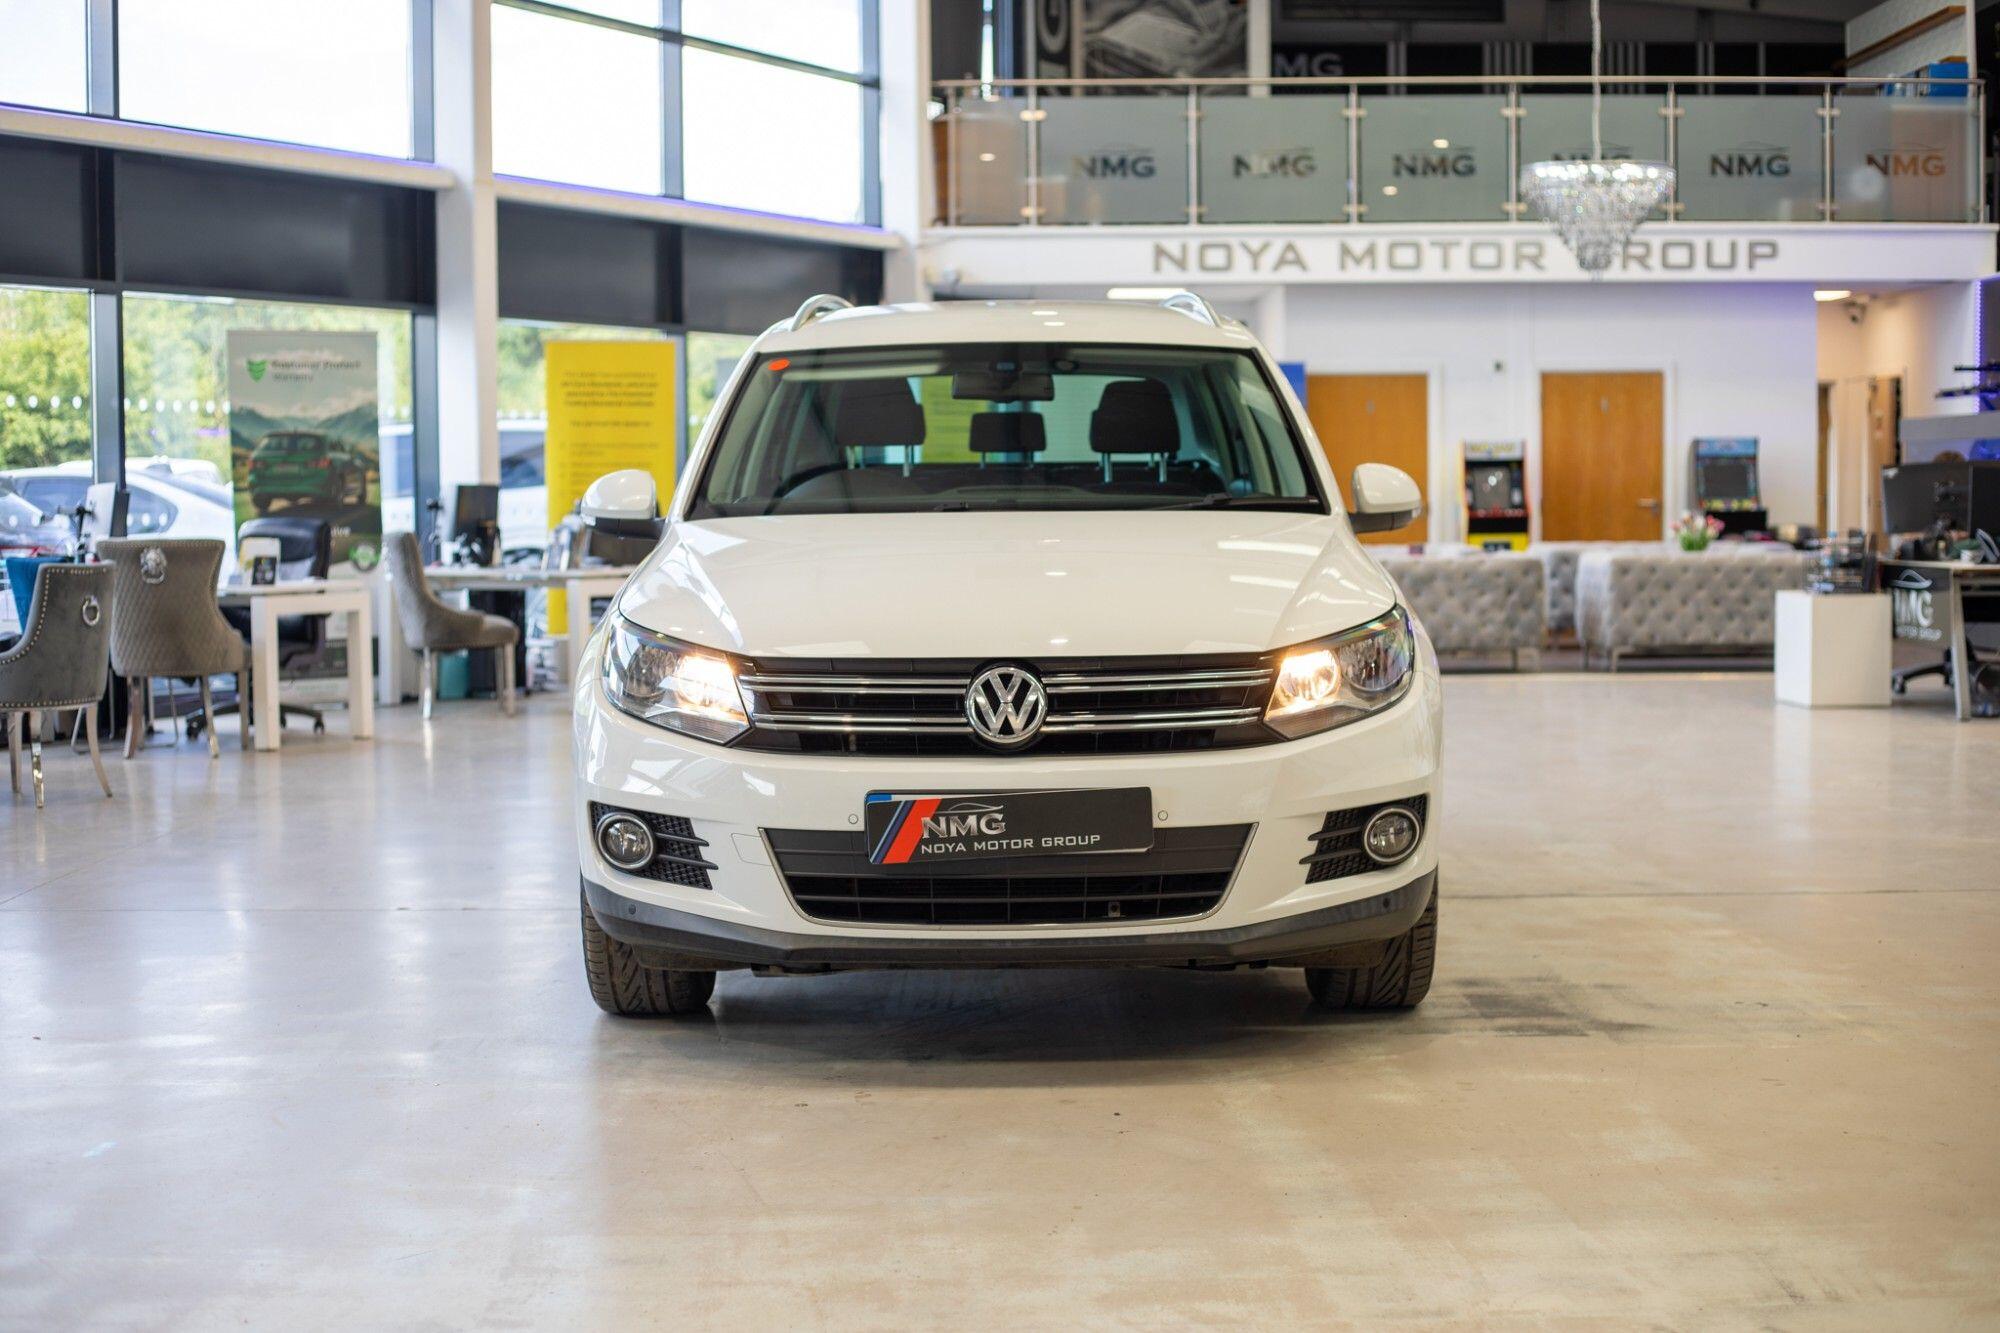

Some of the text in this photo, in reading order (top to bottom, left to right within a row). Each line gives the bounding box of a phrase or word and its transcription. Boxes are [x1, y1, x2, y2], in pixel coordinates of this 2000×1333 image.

[1072, 156, 1155, 178] NMG
[1394, 154, 1476, 178] NMG
[1711, 153, 1791, 178] NMG
[1866, 153, 1947, 177] NMG
[1153, 241, 1779, 271] NOYA MOTOR ROUP
[1894, 588, 1934, 627] MG
[920, 811, 1007, 839] NMG
[921, 834, 1101, 855] NOYA MOTOR GROUP
